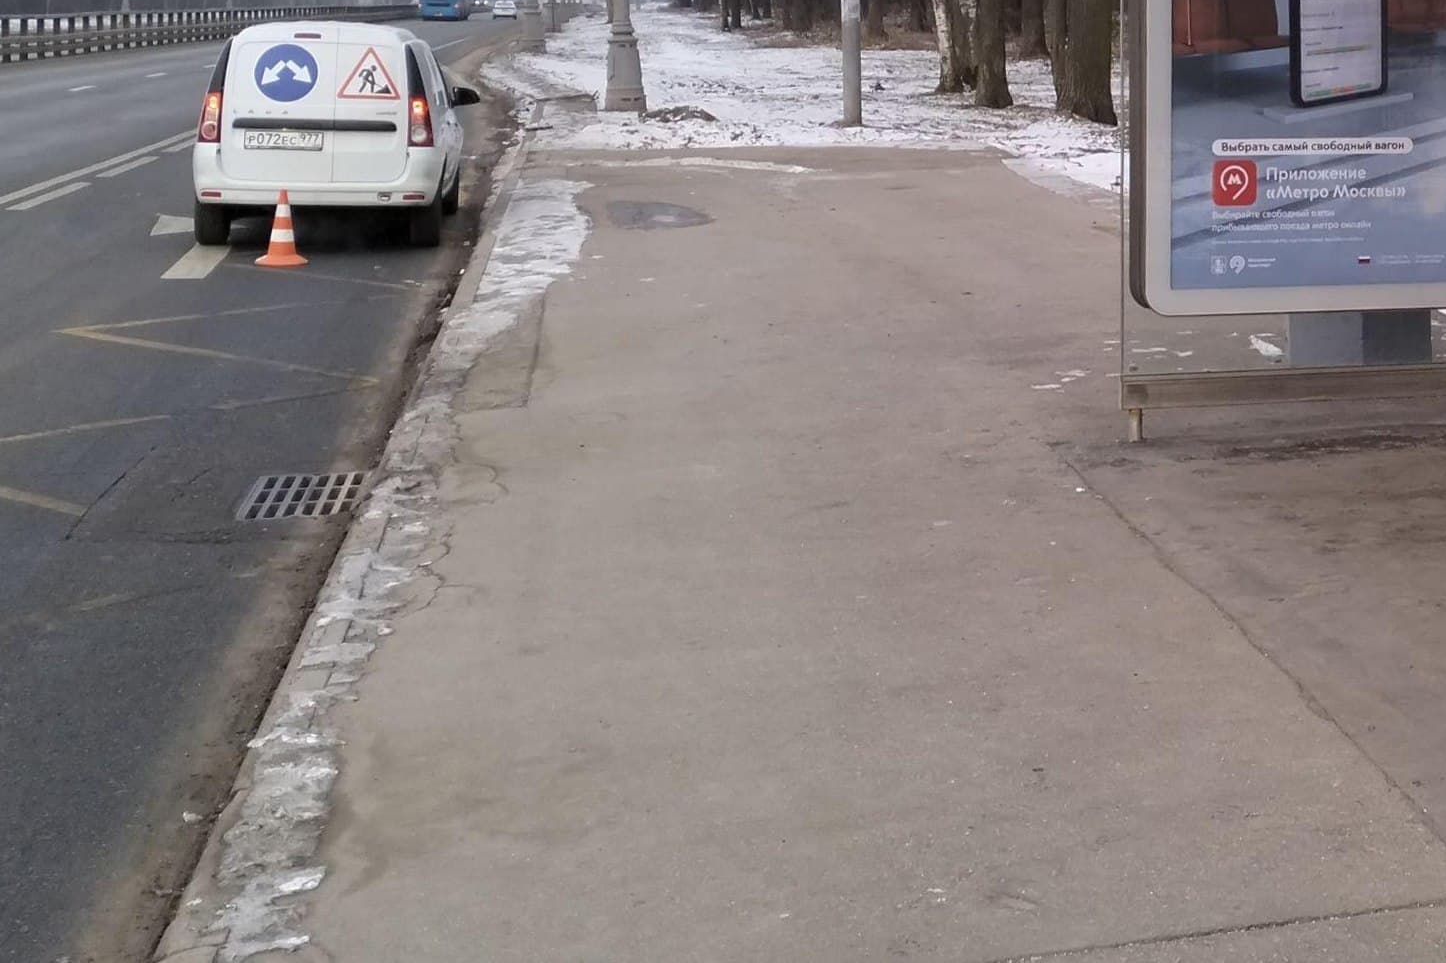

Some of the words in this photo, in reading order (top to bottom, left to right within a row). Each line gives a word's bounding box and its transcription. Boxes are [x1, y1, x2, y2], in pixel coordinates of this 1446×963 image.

[1221, 142, 1270, 153] Выбрать
[1272, 141, 1308, 151] самый
[1311, 139, 1372, 152] свободный
[1374, 141, 1405, 150] вагон
[1266, 167, 1367, 182] Приложение
[1266, 185, 1329, 201] «Метро
[1332, 185, 1406, 199] Москвы»
